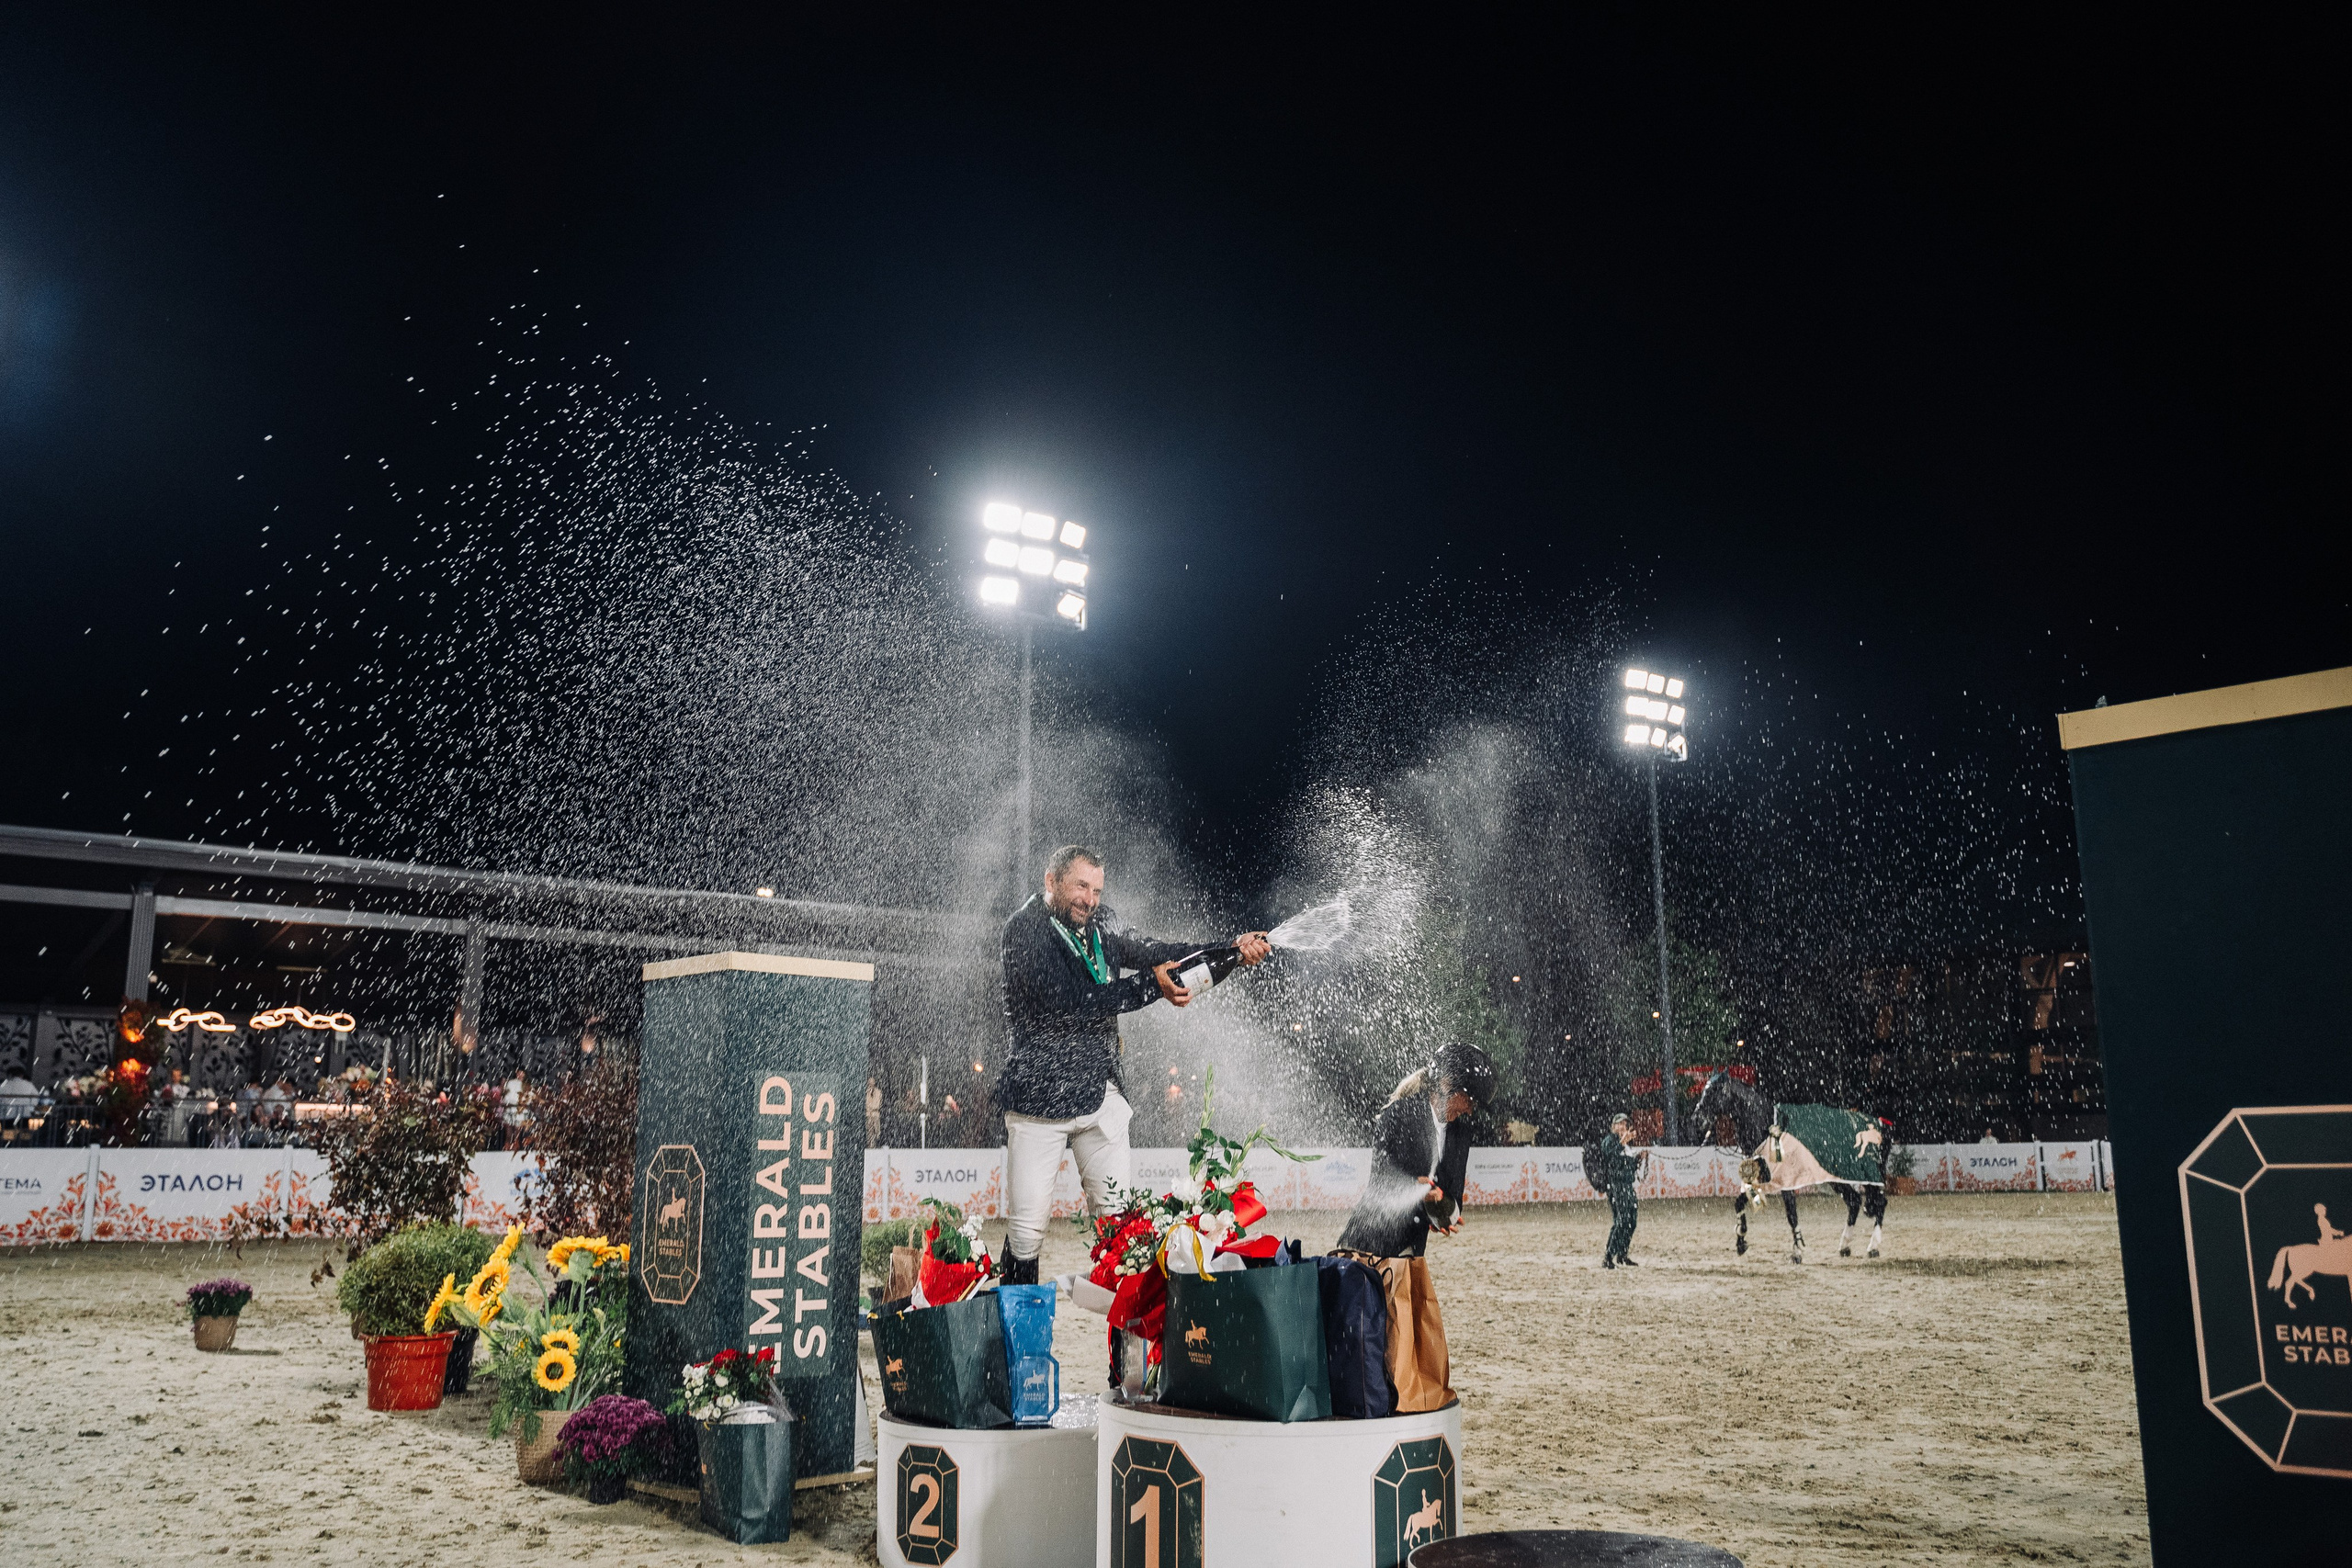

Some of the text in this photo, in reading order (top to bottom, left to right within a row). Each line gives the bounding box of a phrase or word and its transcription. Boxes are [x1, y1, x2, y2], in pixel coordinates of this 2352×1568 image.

[1544, 1162, 1580, 1174] ЭТАЛОН
[1969, 1156, 2018, 1168] ЭТАЛОН
[140, 1174, 243, 1191] ЭТАЛОН
[915, 1169, 978, 1184] ЭТАЛОН
[793, 1092, 835, 1359] STABLES
[2275, 1324, 2352, 1345] EMER
[909, 1472, 940, 1539] 2
[1130, 1484, 1160, 1568] 1
